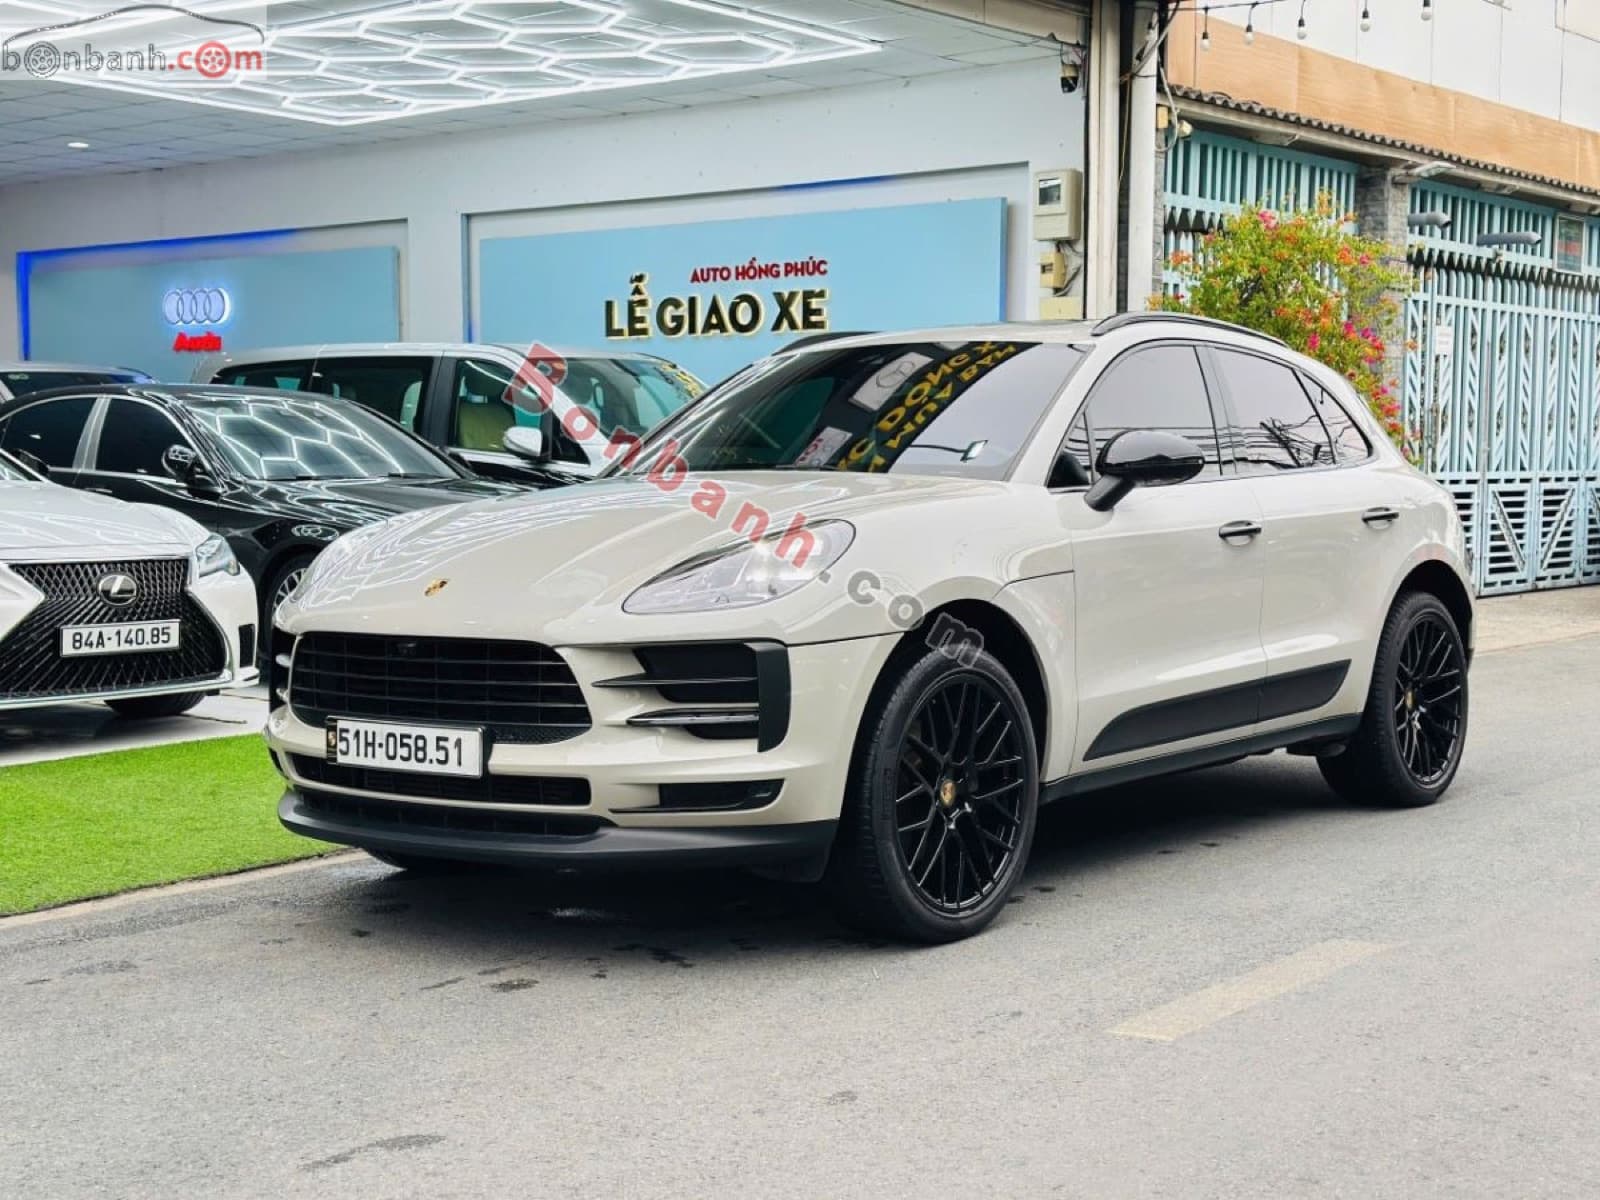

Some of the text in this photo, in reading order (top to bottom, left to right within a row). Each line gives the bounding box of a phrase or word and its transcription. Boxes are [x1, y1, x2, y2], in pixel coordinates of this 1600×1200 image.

[690, 256, 828, 283] AUTO HỒNG PHÚC
[604, 273, 828, 338] LỄ GIAO XE
[72, 626, 171, 649] 84A-140.85
[338, 728, 462, 767] 51H-058.51
